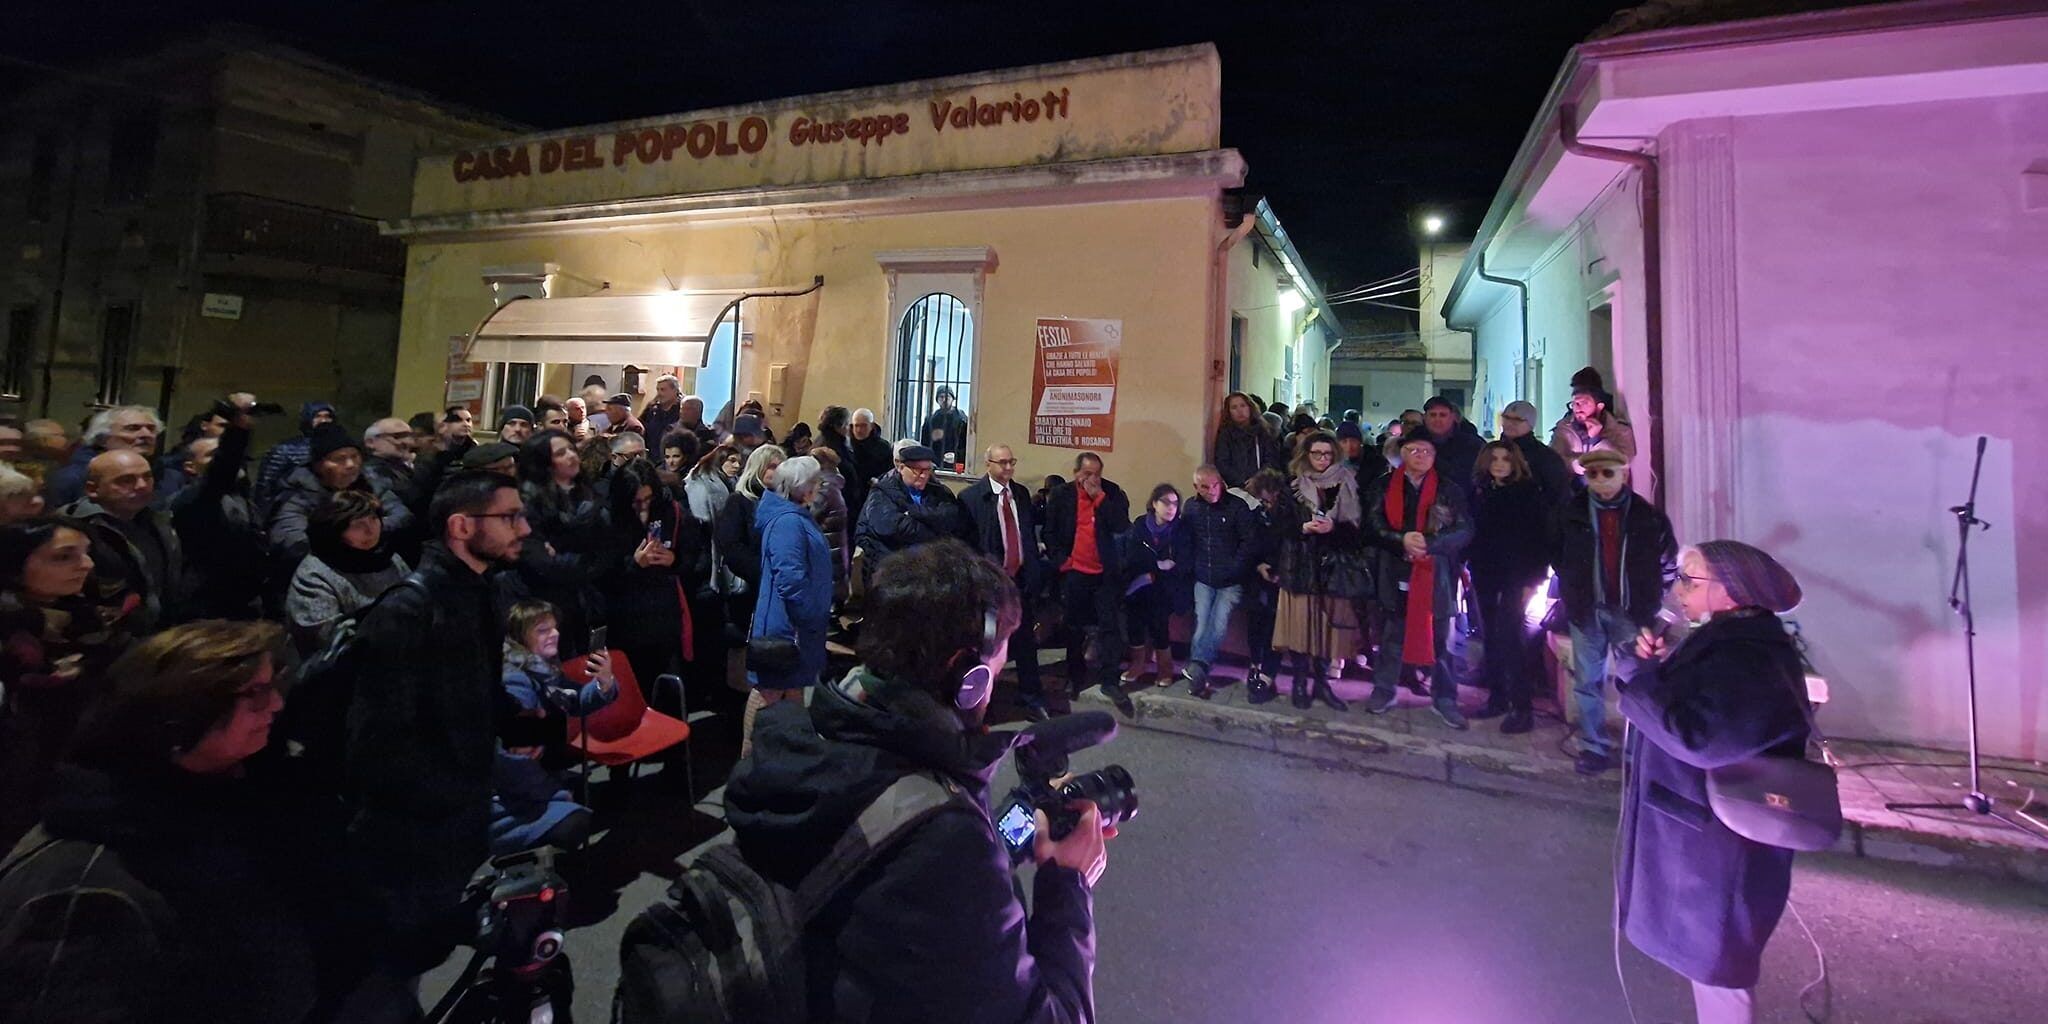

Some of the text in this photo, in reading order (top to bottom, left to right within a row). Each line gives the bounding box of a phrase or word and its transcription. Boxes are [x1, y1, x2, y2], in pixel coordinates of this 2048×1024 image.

[453, 87, 1070, 183] CASA DEL POPOLO Giuseppe Valarioti
[1037, 325, 1072, 348] FESTA!
[1034, 416, 1092, 427] SABATO 13 GENNAIO
[1035, 426, 1052, 435] DALLE
[1052, 426, 1064, 435] ORE
[1035, 435, 1046, 444] VIA
[1081, 436, 1111, 447] ROSARNO
